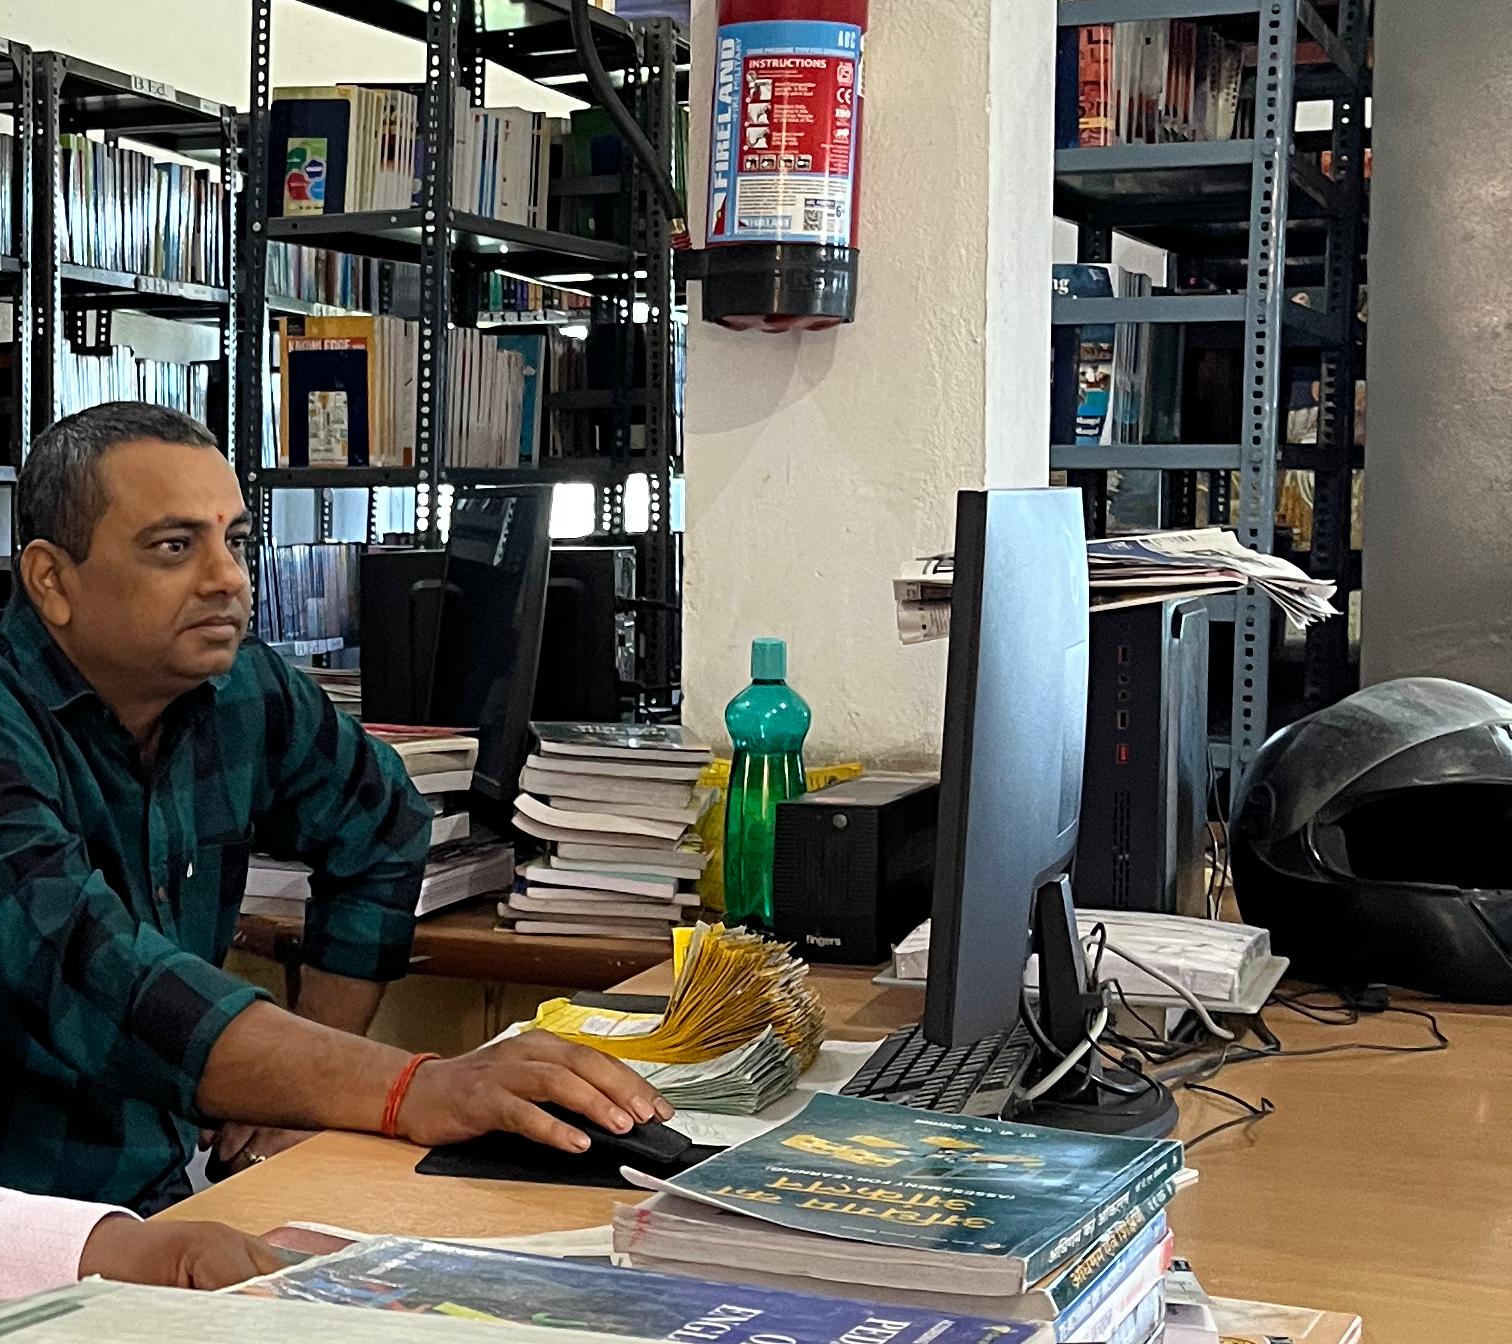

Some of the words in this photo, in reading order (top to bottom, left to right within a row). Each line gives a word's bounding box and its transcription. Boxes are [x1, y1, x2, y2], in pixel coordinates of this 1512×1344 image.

[749, 59, 827, 69] INSTRUCTIONS
[714, 38, 735, 188] FIRELAND
[765, 1166, 854, 1181] LEARNING)
[856, 1176, 892, 1186] FOR
[706, 1184, 782, 1205] का
[765, 1175, 975, 1212] आंकलन
[896, 1180, 1015, 1201] (ASSESSMENT
[794, 1197, 995, 1229] अधिगम
